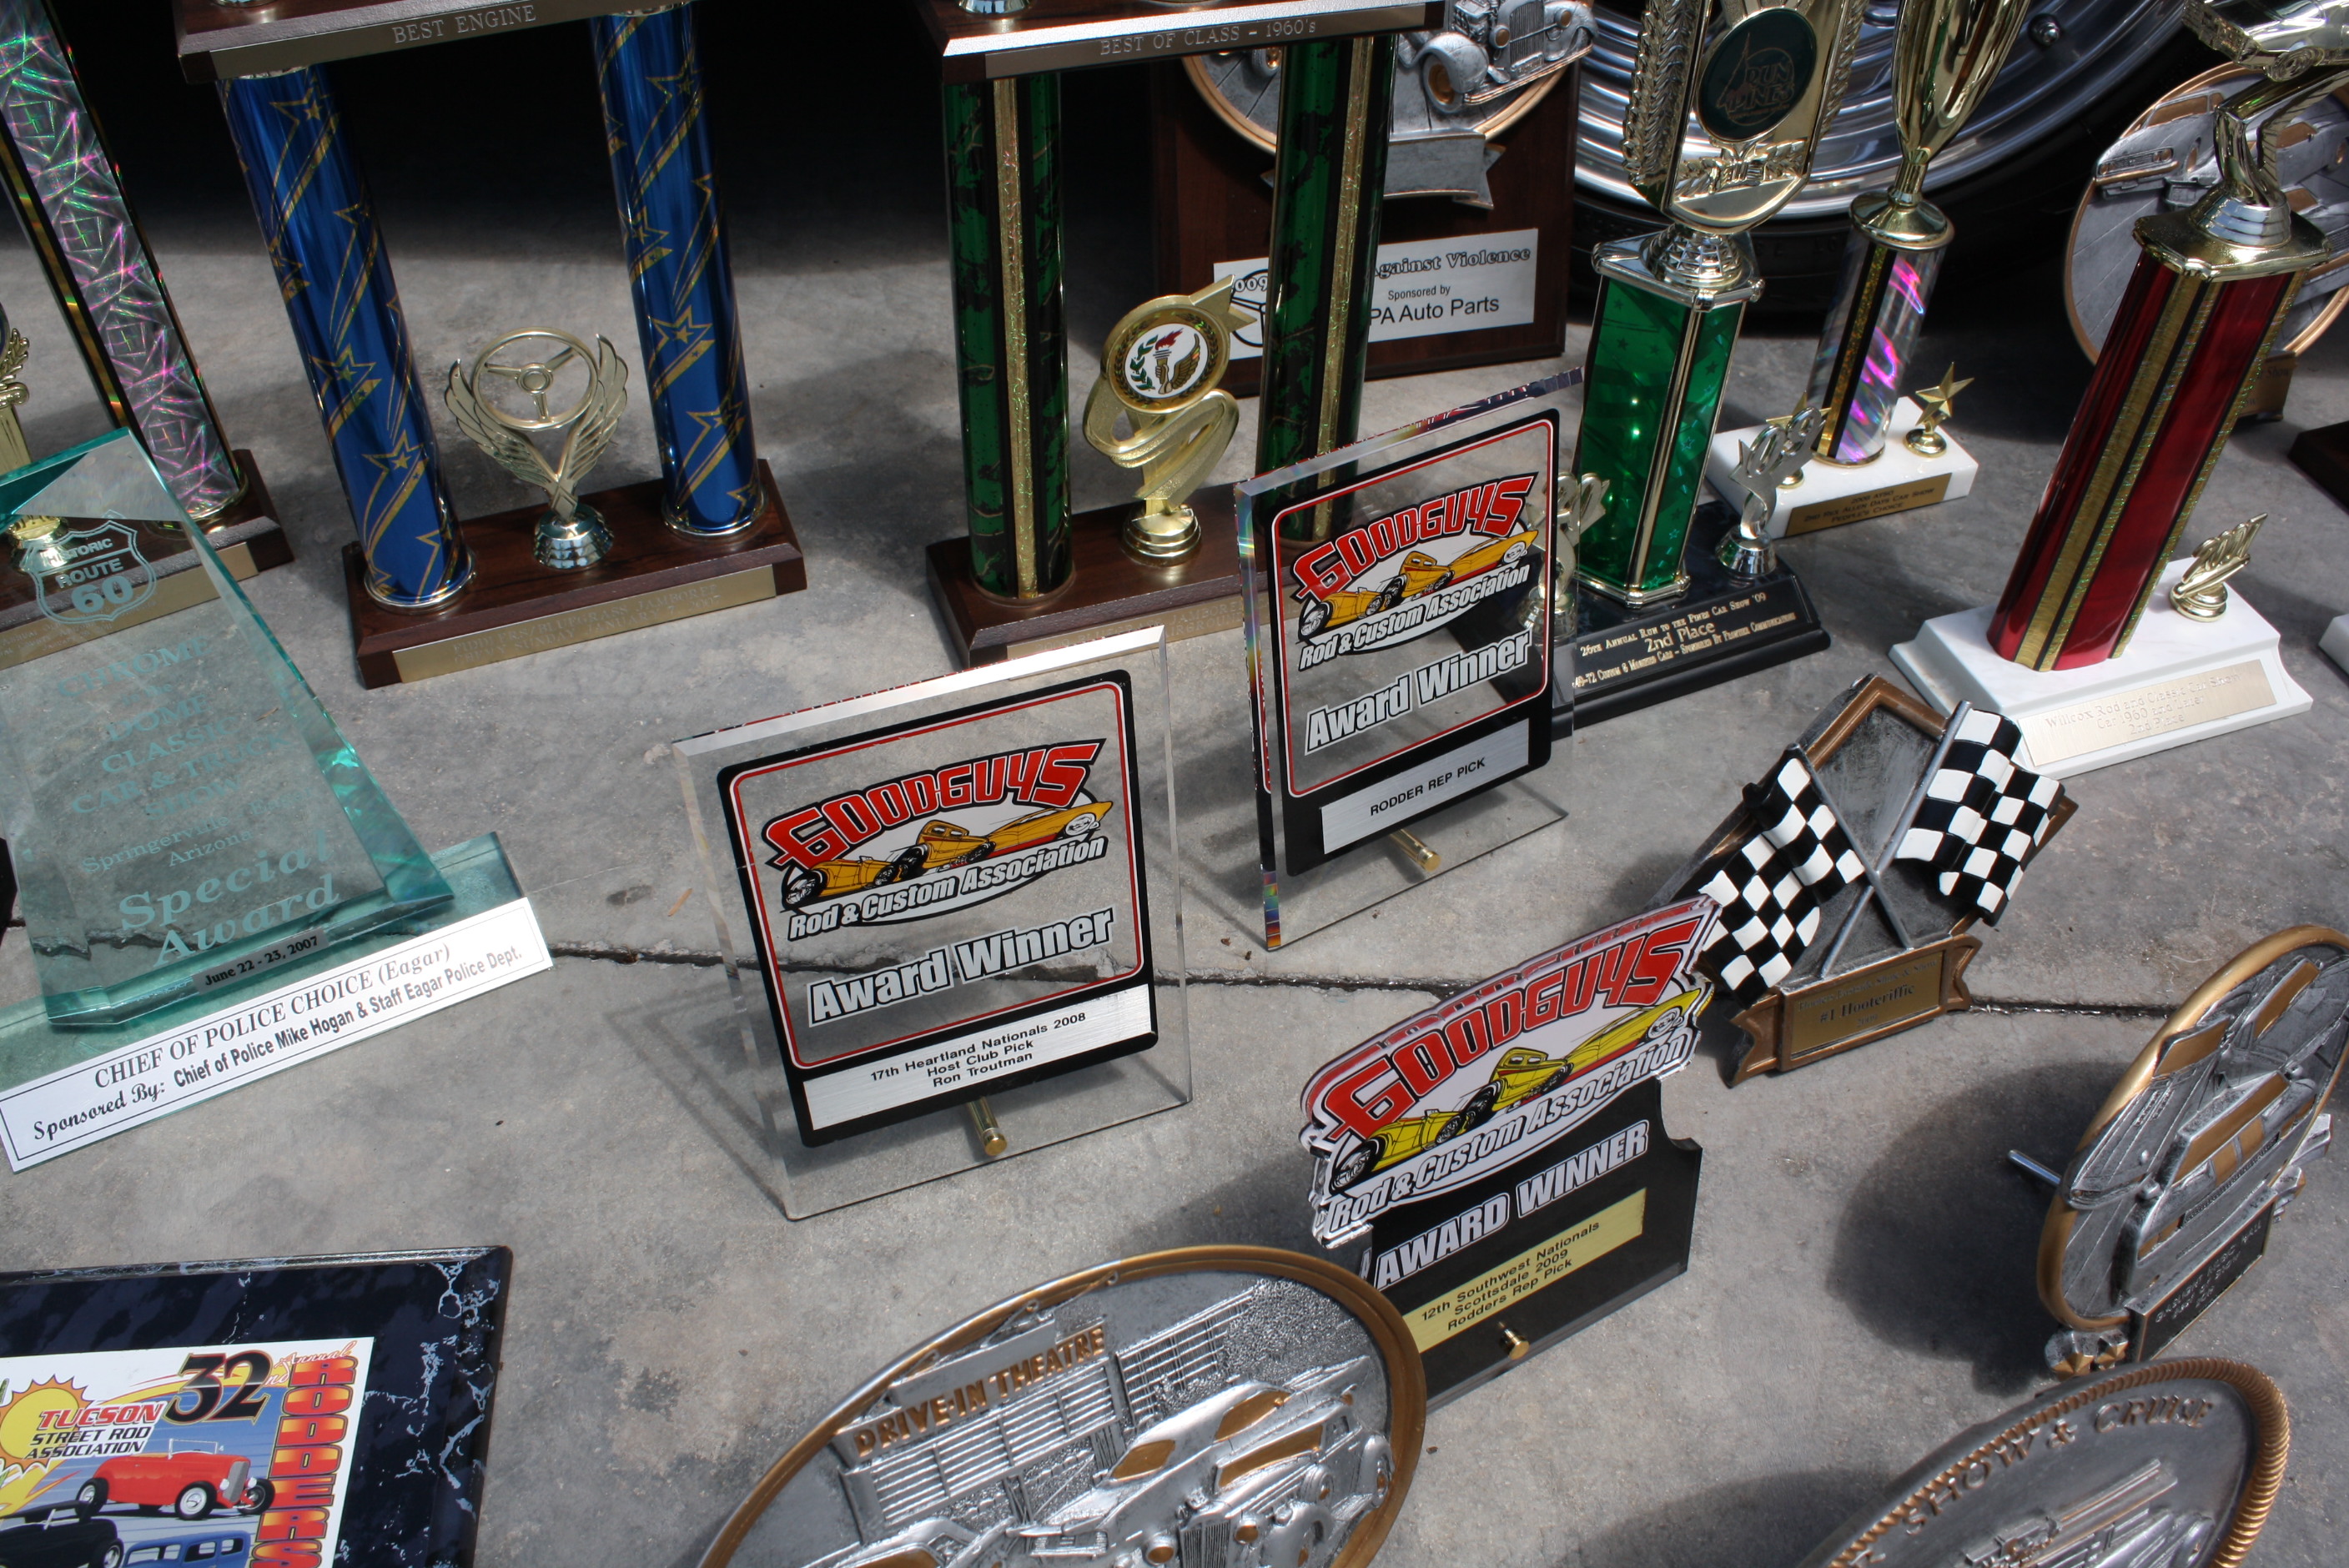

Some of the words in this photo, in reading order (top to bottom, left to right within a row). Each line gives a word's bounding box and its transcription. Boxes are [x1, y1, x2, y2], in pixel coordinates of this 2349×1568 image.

[392, 20, 444, 43] BEST
[455, 5, 536, 33] ENGINE
[1100, 37, 1144, 55] BEST
[1153, 33, 1176, 48] OF
[1185, 26, 1240, 46] CLASS
[1266, 19, 1316, 38] 1960's
[1230, 276, 1269, 292] 009
[1446, 248, 1531, 269] Violence
[1388, 284, 1436, 301] Sponsored
[1440, 284, 1451, 296] by
[1369, 306, 1396, 326] PA
[1399, 303, 1443, 323] Auto
[1451, 296, 1500, 317] Parts
[41, 538, 114, 568] HISTORIC
[1292, 474, 1537, 602] GOODGUYS
[55, 558, 124, 589] ROUTE
[71, 575, 133, 614] 60
[1300, 638, 1337, 671] Rod
[1338, 633, 1354, 654] &
[1353, 606, 1424, 650] Custom
[1426, 563, 1531, 625] Association
[1644, 632, 1674, 654] 2nd
[1677, 621, 1716, 643] Place
[57, 635, 213, 697] CHROME
[1306, 672, 1411, 753] Award
[1416, 628, 1532, 707] Winner
[106, 694, 211, 741] DOME
[2045, 711, 2093, 729] Willcox
[2095, 702, 2121, 716] Rod
[2125, 696, 2145, 710] and
[2148, 686, 2186, 704] Classic
[2189, 681, 2208, 694] Car
[2210, 672, 2243, 688] Show
[2096, 717, 2116, 730] Car
[2121, 709, 2148, 724] 1960
[2152, 702, 2173, 716] and
[2176, 696, 2204, 710] Later
[2128, 721, 2150, 736] 2nd
[2154, 712, 2185, 730] Place
[71, 780, 143, 814] CAR
[151, 771, 176, 789] &
[179, 731, 292, 778] TRUCK
[102, 716, 242, 773] CLASSIC
[144, 774, 243, 821] SHOW
[765, 739, 1106, 871] GOODGUYS
[1370, 784, 1424, 816] RODDER
[1428, 772, 1453, 791] REP
[1457, 757, 1486, 778] PICK
[83, 815, 231, 874] Springerville
[169, 830, 254, 867] Arizona
[118, 829, 333, 930] Special
[788, 907, 837, 942] Rod
[841, 903, 861, 925] &
[861, 873, 958, 920] Custom
[959, 835, 1108, 896] Association
[153, 873, 340, 968] Award
[206, 966, 236, 986] June
[237, 956, 255, 974] 22
[264, 949, 286, 967] 23,
[287, 935, 319, 955] 2007
[809, 945, 952, 1028] Award
[953, 907, 1114, 984] Winner
[95, 1048, 163, 1088] CHIEF
[169, 1034, 199, 1059] OF
[206, 1002, 288, 1048] POLICE
[291, 970, 374, 1015] CHOICE
[377, 942, 450, 986] (Eagar)
[1325, 917, 1703, 1139] GOODGUYS
[1819, 1008, 1835, 1023] #1
[1840, 983, 1915, 1018] Hooteriffic
[33, 1090, 127, 1141] Sponsored
[131, 1080, 166, 1102] By:
[174, 1058, 211, 1087] Chief
[214, 1053, 229, 1073] of
[230, 1038, 274, 1067] Police
[274, 1026, 309, 1050] Mike
[309, 1009, 355, 1036] Hogan
[357, 1003, 369, 1018] &
[369, 988, 403, 1013] Staff
[404, 975, 444, 1002] Eagar
[445, 959, 485, 985] Police
[488, 945, 523, 973] Dept.
[870, 1066, 899, 1081] 17th
[905, 1044, 976, 1070] Heartland
[982, 1024, 1048, 1049] Nationals
[1053, 1012, 1086, 1030] 2008
[927, 1062, 960, 1078] Host
[966, 1050, 999, 1067] Club
[1004, 1039, 1034, 1056] Pick
[933, 1074, 962, 1088] Ron
[967, 1053, 1034, 1078] Troutman
[1333, 1183, 1395, 1232] Rod
[1392, 1173, 1416, 1199] &
[1416, 1117, 1525, 1190] Custom
[1527, 1031, 1684, 1133] Association
[1376, 1193, 1510, 1292] AWARD
[1517, 1120, 1650, 1218] WINNER
[1421, 1300, 1451, 1321] 12th
[1456, 1257, 1532, 1302] Southwest
[1537, 1221, 1600, 1260] Nationals
[1447, 1293, 1507, 1331] Rodders
[1512, 1278, 1539, 1297] Rep
[1543, 1259, 1572, 1279] Pick
[1454, 1270, 1529, 1314] Scottsdale
[1536, 1249, 1569, 1272] 2009
[274, 1340, 358, 1369] Annual
[38, 1403, 164, 1430] TUCSON
[853, 1378, 988, 1458] DRIVE-IN
[988, 1327, 1106, 1398] THEATRE
[24, 1441, 144, 1460] ASSOCIATION
[30, 1429, 106, 1446] STREET
[108, 1426, 152, 1440] ROD
[250, 1356, 359, 1568] RODDERS
[1904, 1427, 2041, 1536] SHOW
[2047, 1419, 2078, 1450] &
[2094, 1395, 2216, 1434] CRUISE
